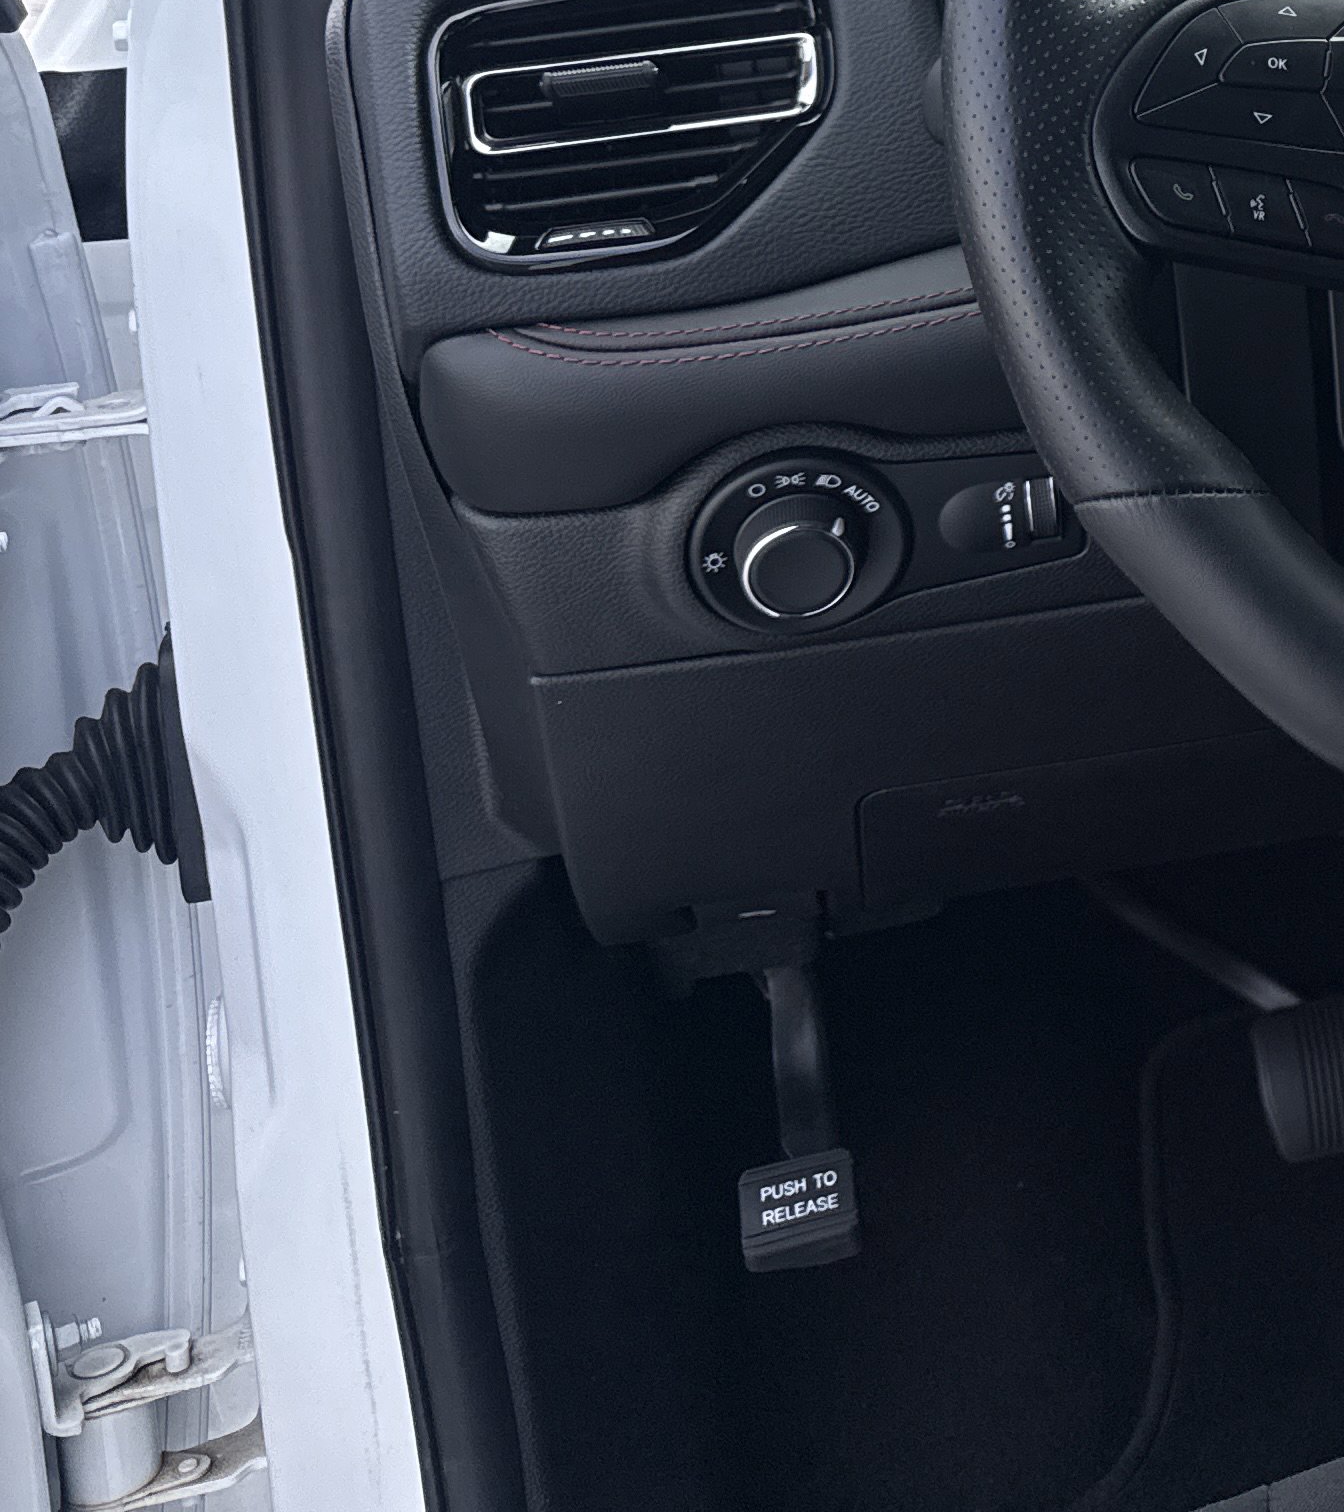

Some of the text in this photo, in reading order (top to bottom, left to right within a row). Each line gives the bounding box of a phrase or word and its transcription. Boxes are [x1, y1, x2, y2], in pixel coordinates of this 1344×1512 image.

[1267, 57, 1288, 71] OK
[1253, 209, 1266, 222] VR
[844, 484, 881, 514] AUTO
[760, 1170, 838, 1203] PUSH TO
[762, 1192, 839, 1226] RELEASE
